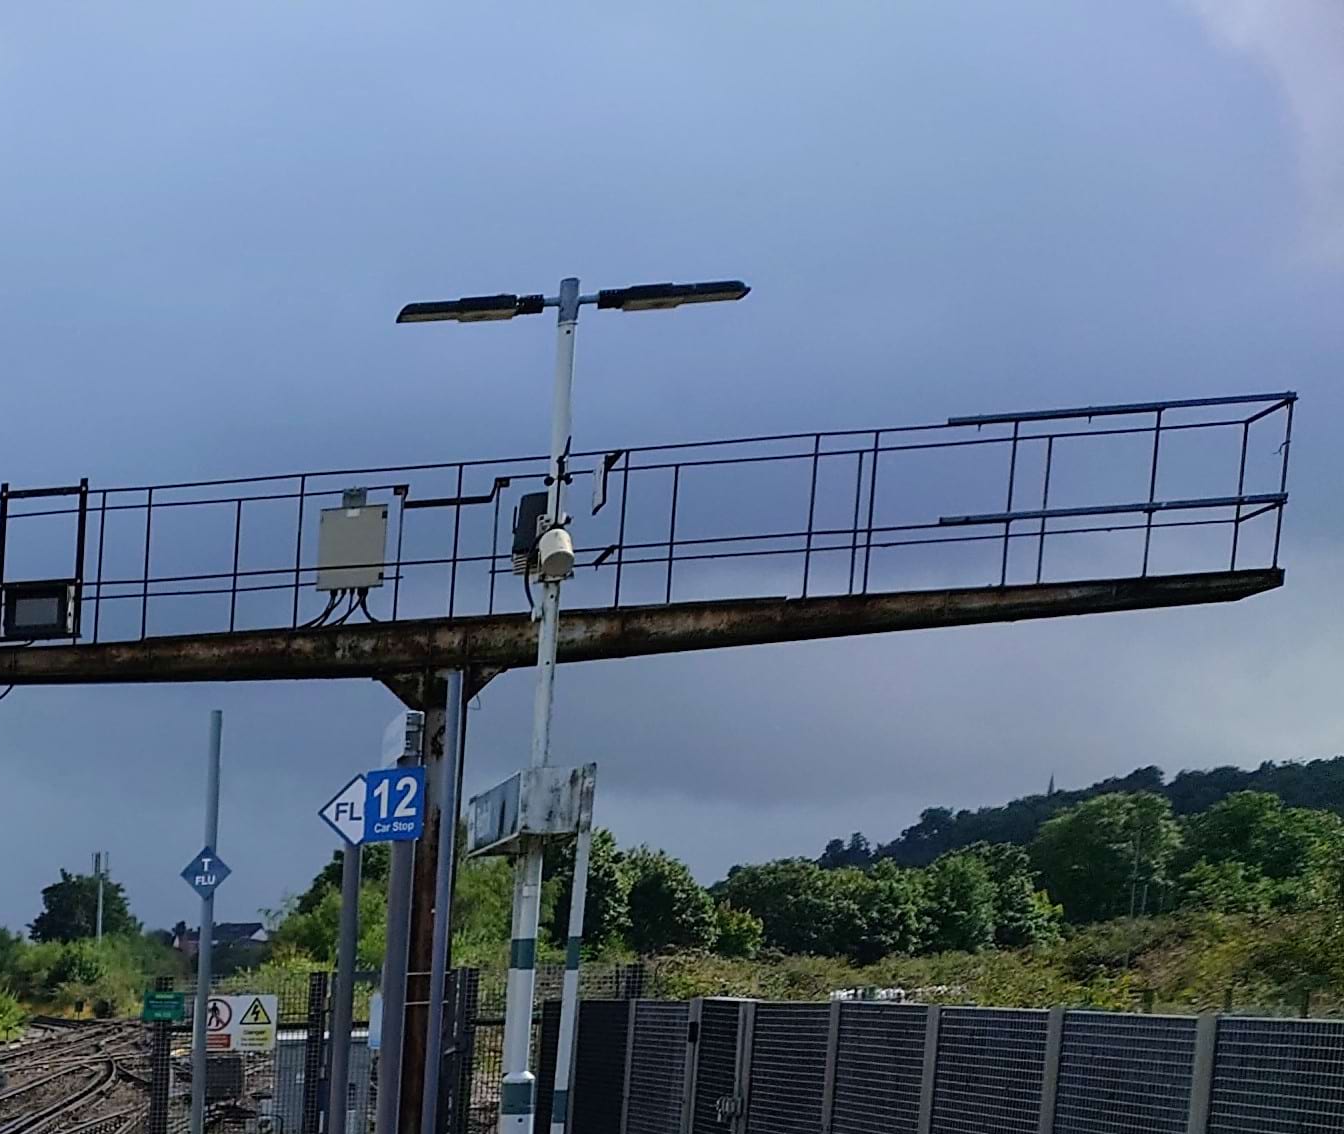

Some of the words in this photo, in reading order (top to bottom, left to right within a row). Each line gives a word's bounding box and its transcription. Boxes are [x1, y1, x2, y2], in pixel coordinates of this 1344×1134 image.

[373, 776, 418, 819] 12
[374, 823, 391, 833] Car
[392, 821, 415, 833] Stop
[201, 858, 211, 872] T
[195, 874, 216, 886] FLU
